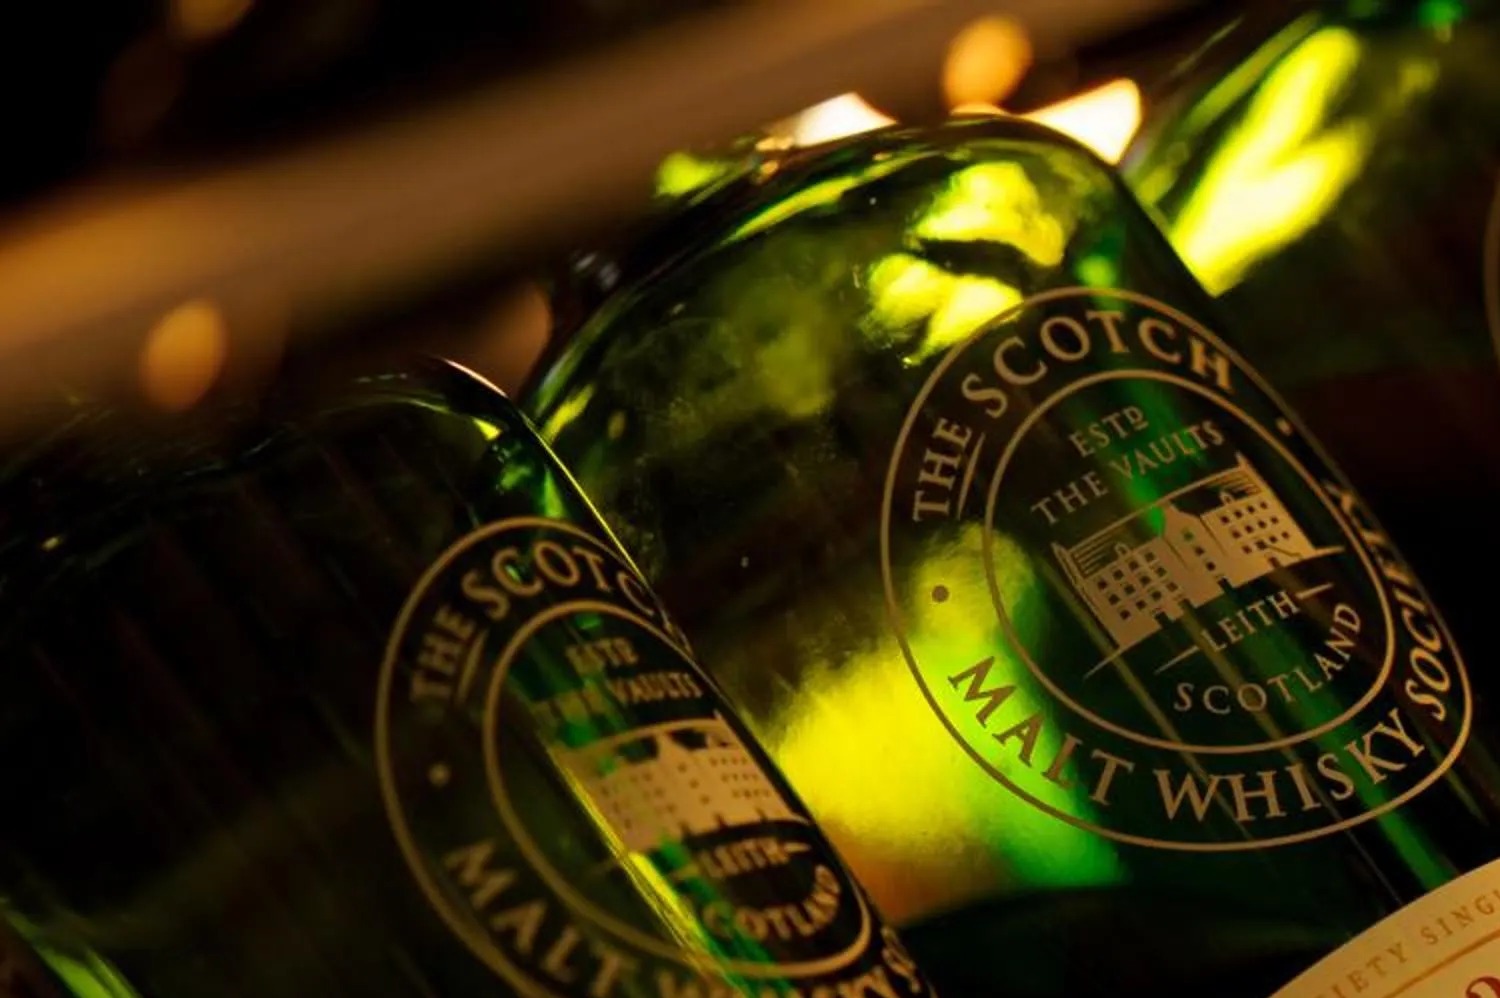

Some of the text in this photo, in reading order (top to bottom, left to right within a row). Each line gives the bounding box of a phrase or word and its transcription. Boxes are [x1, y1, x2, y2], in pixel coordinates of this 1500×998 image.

[912, 311, 1233, 522] THE SCOTCH
[1030, 420, 1226, 527] THE VAULTS
[409, 603, 477, 702] THE
[1173, 603, 1362, 715] SCOTLAND
[1201, 588, 1301, 654] LEITH
[948, 656, 1134, 806] MALT
[1153, 708, 1426, 824] WHISKY
[443, 841, 638, 998] MALT
